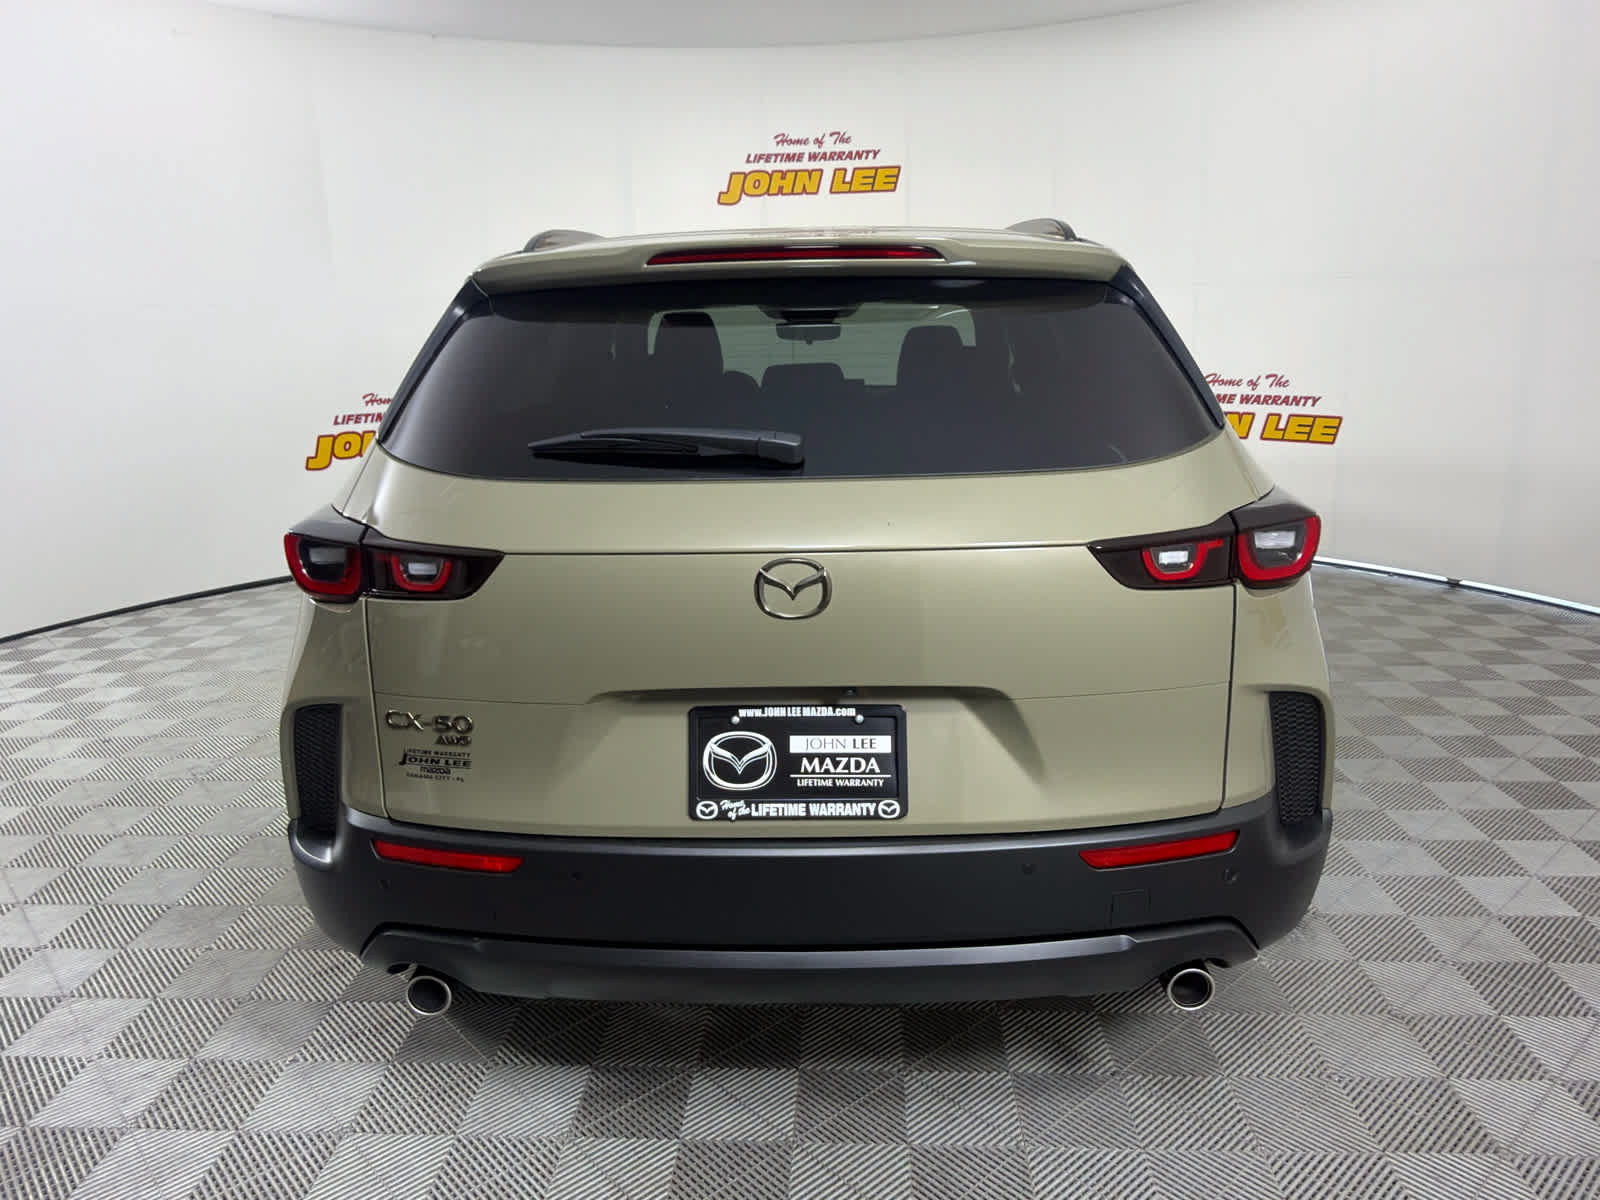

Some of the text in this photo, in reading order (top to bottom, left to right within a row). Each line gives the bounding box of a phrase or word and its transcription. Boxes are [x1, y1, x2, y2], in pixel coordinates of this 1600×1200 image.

[774, 131, 852, 148] Home of The
[745, 149, 880, 164] LIFETIME WARRANTY
[717, 165, 902, 205] JOHN LEE
[1246, 375, 1260, 391] of
[1265, 373, 1290, 388] The
[1239, 394, 1322, 407] WARRANTY
[1260, 412, 1343, 445] LEE
[385, 709, 473, 734] CX-50
[805, 737, 877, 750] JOHN LEE
[398, 753, 473, 768] JOHN LEE
[800, 757, 881, 773] MAZDA
[797, 778, 884, 787] LIFETIME WARRANTY
[751, 803, 877, 817] LIFETIME WARRANTY
